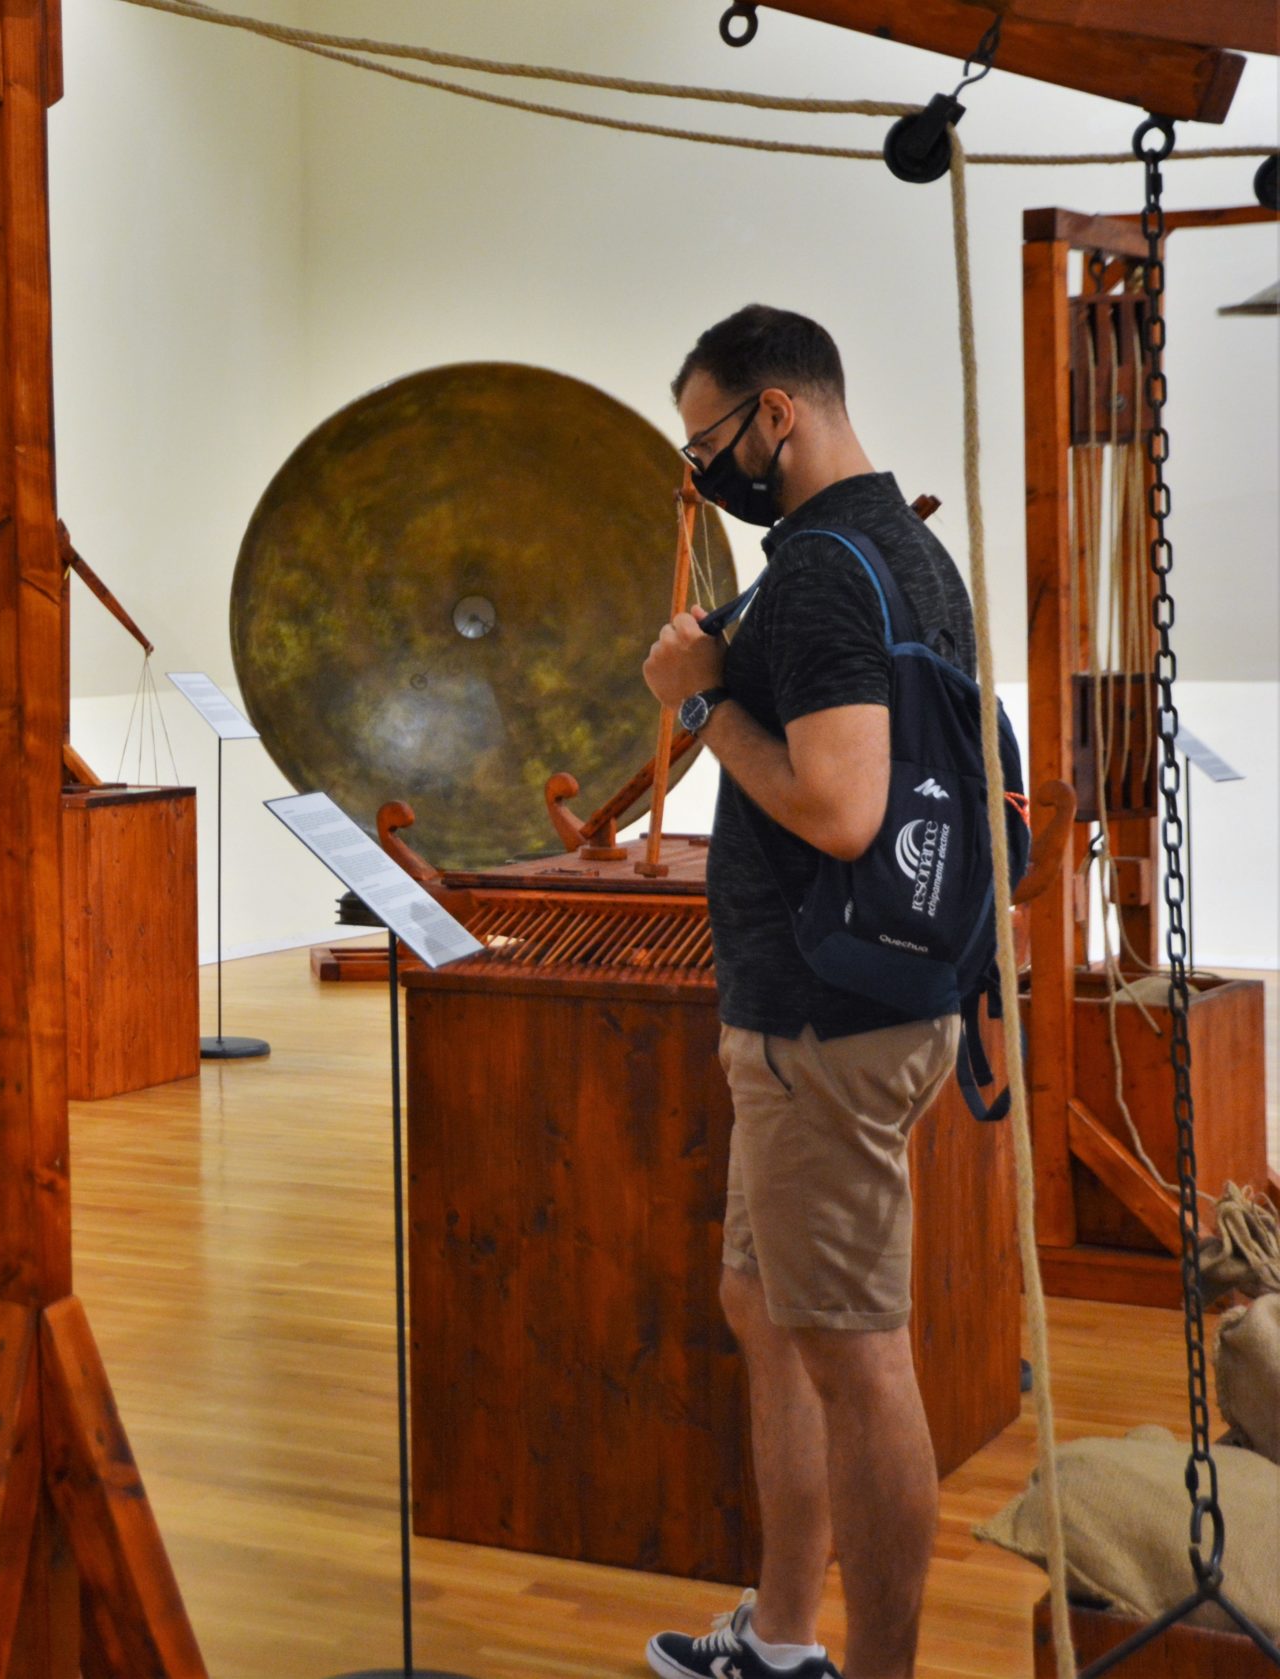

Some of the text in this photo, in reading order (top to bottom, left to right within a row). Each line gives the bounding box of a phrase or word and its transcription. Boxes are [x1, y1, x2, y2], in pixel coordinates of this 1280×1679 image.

[912, 820, 938, 911] resonance
[927, 823, 950, 917] echipamente electrice
[879, 934, 928, 952] Quechua
